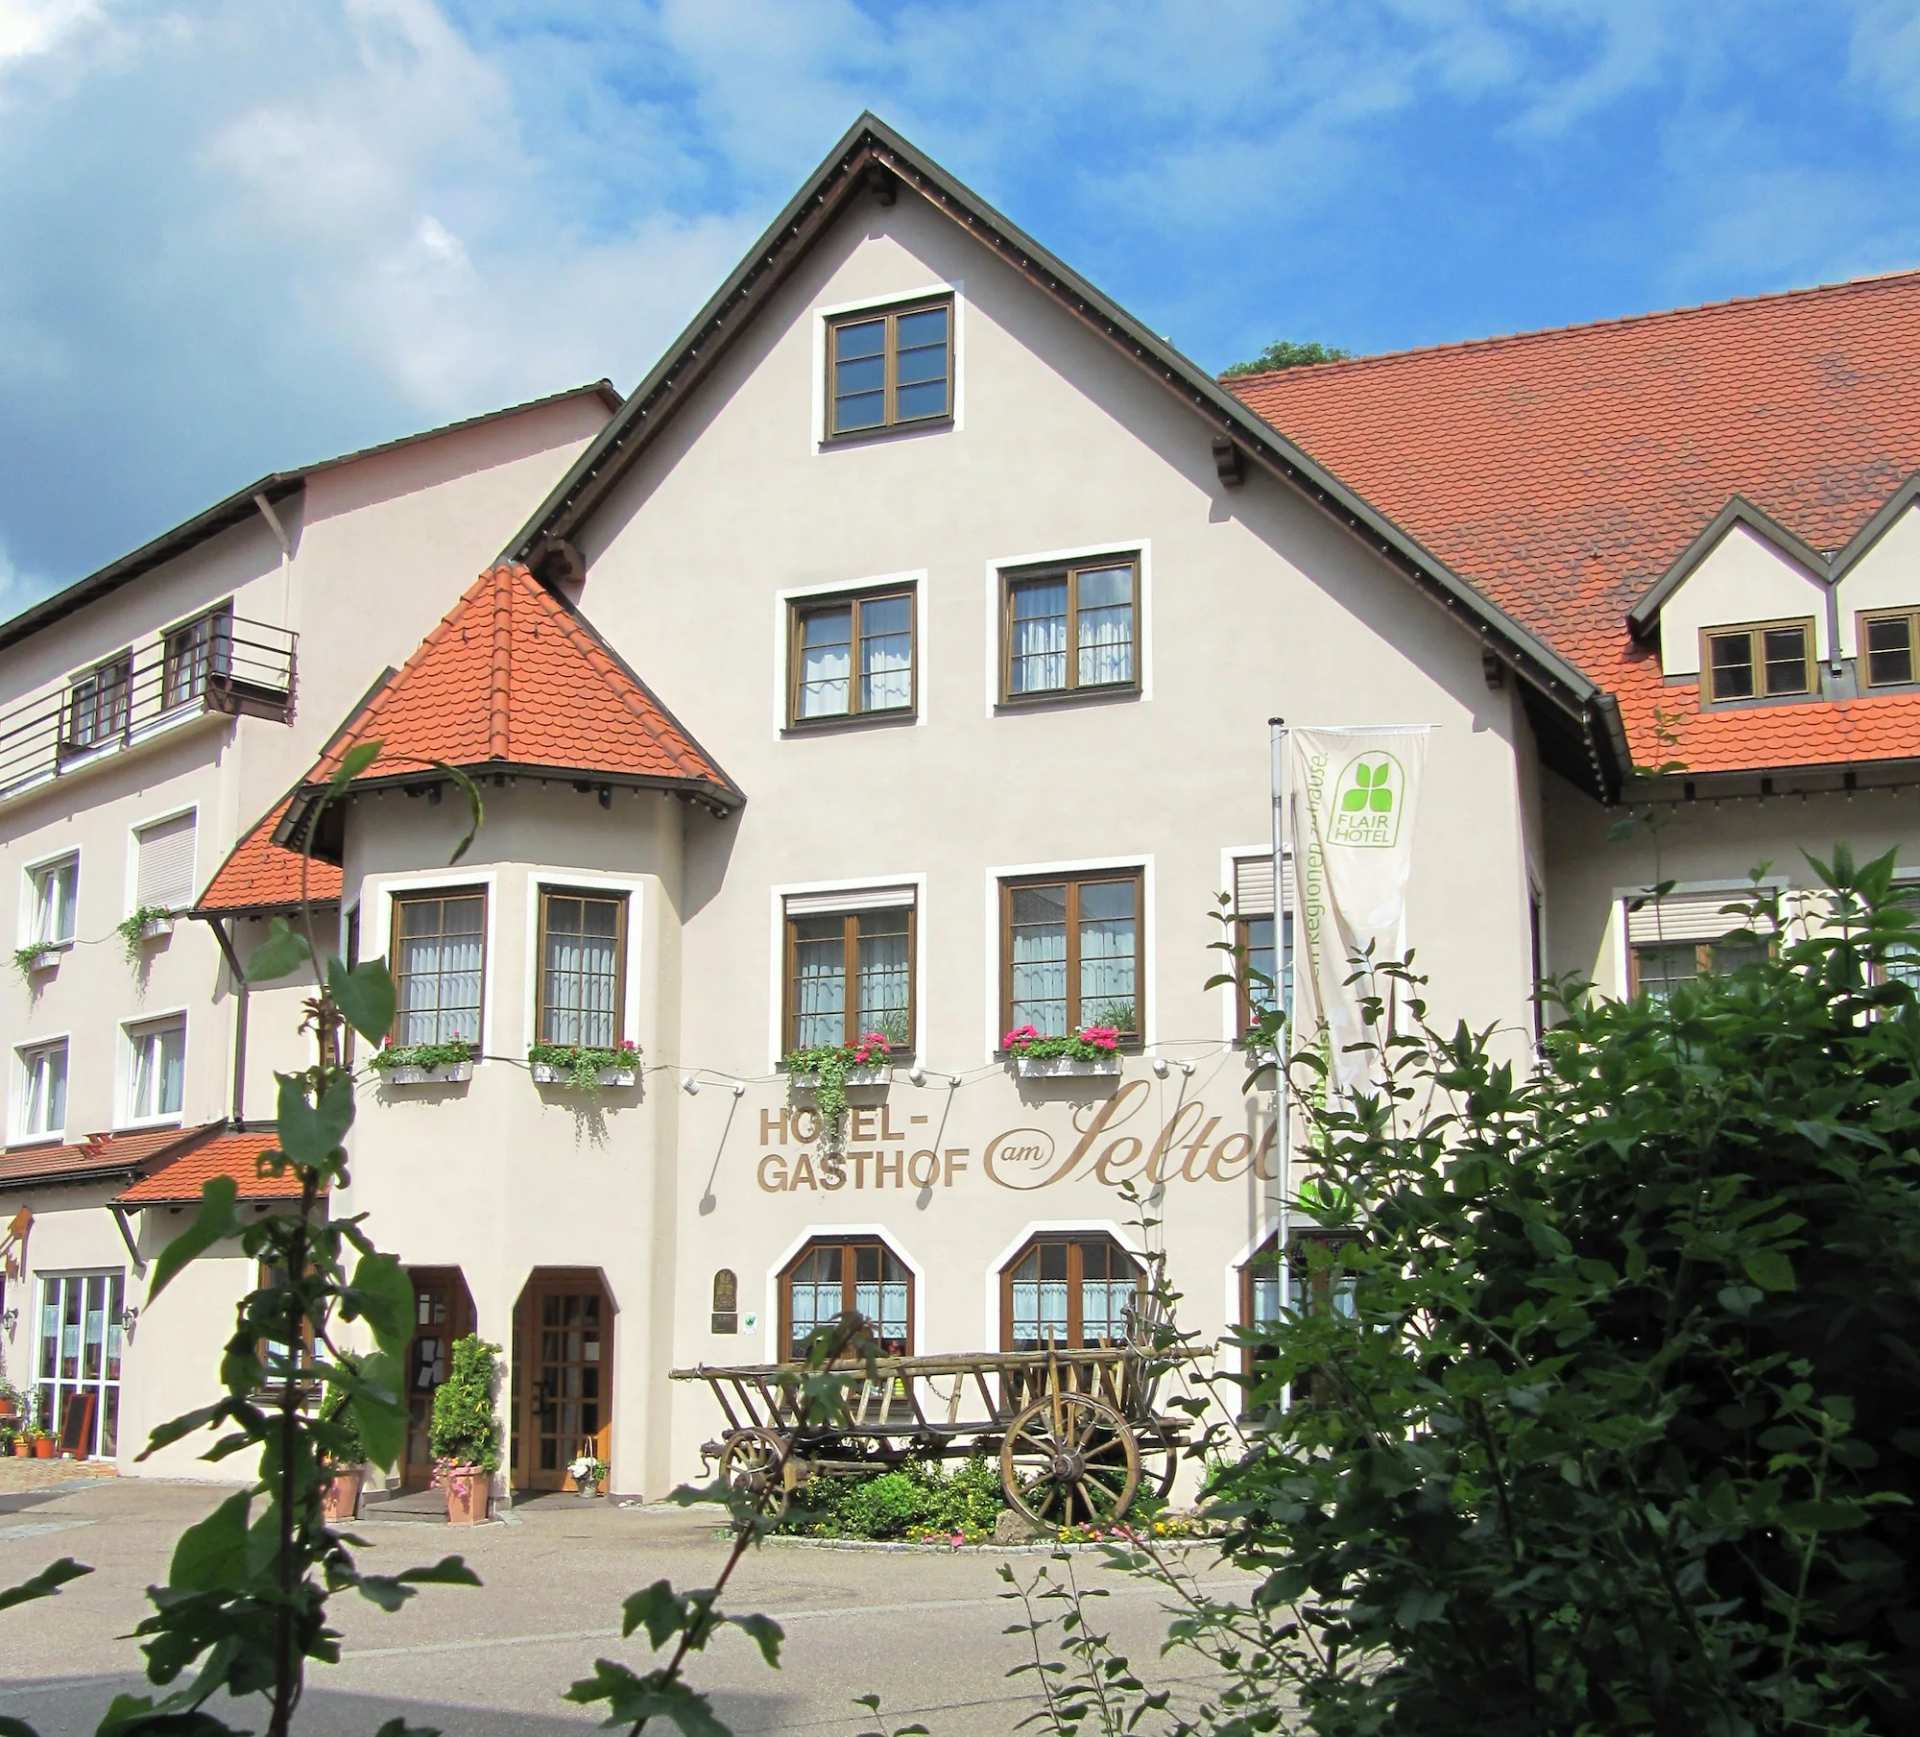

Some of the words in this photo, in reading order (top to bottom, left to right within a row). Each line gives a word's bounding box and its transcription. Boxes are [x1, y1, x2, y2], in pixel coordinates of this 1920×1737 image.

[1338, 814, 1389, 828] FLAIR
[1335, 828, 1389, 842] HOTEL
[760, 1103, 929, 1145] HOEL-
[1000, 1143, 1043, 1161] am
[757, 1148, 970, 1193] GASTHOF
